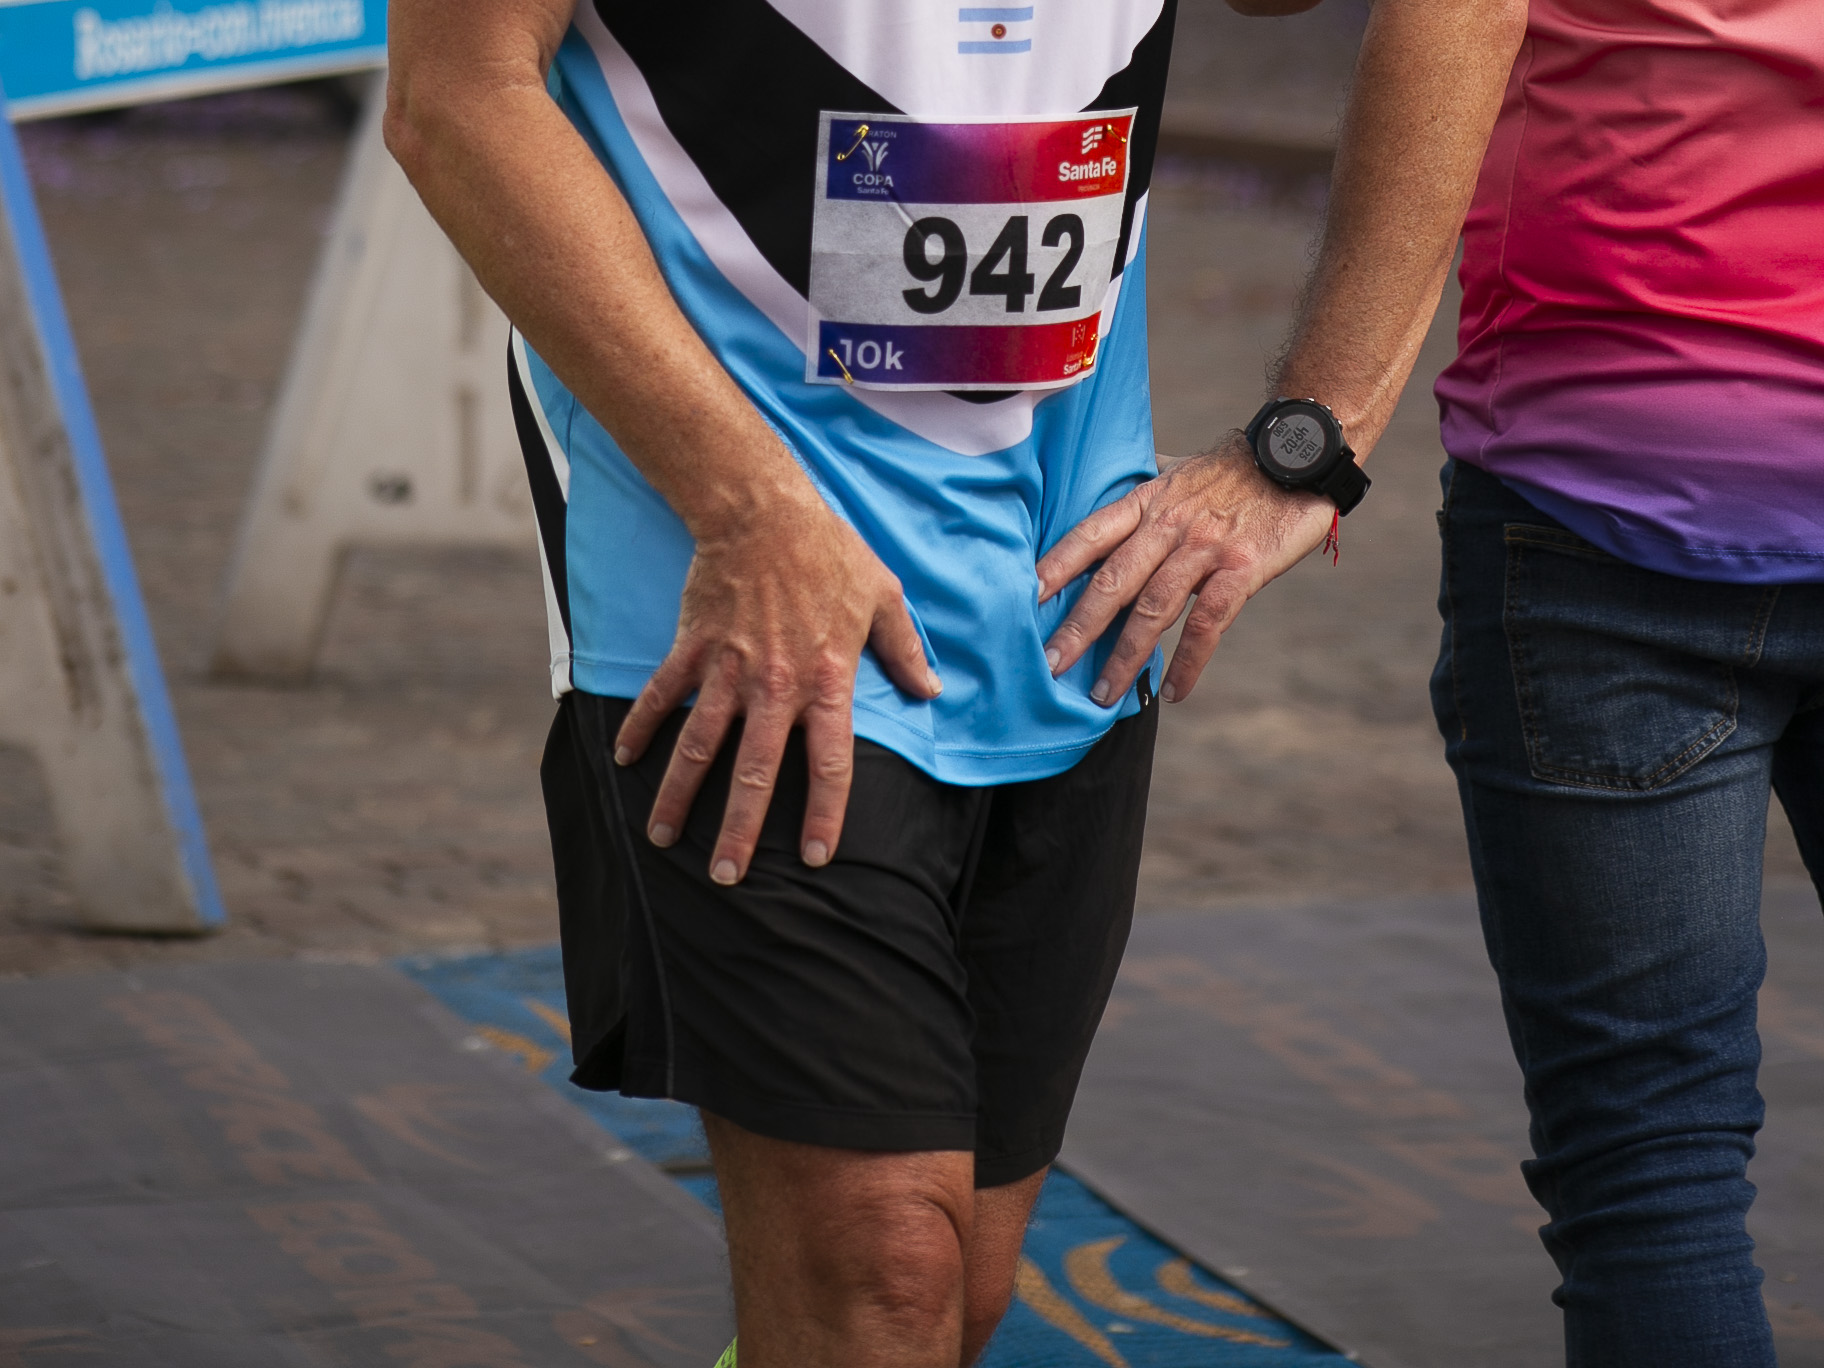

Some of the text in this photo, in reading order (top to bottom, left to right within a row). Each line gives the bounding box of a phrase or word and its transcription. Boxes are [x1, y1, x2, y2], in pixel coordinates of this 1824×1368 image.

[853, 173, 894, 188] COPA
[1058, 157, 1117, 182] Santa Fe
[857, 186, 880, 194] Santa
[902, 213, 1085, 314] 942
[839, 339, 905, 370] 10k
[1280, 427, 1309, 454] 49:02
